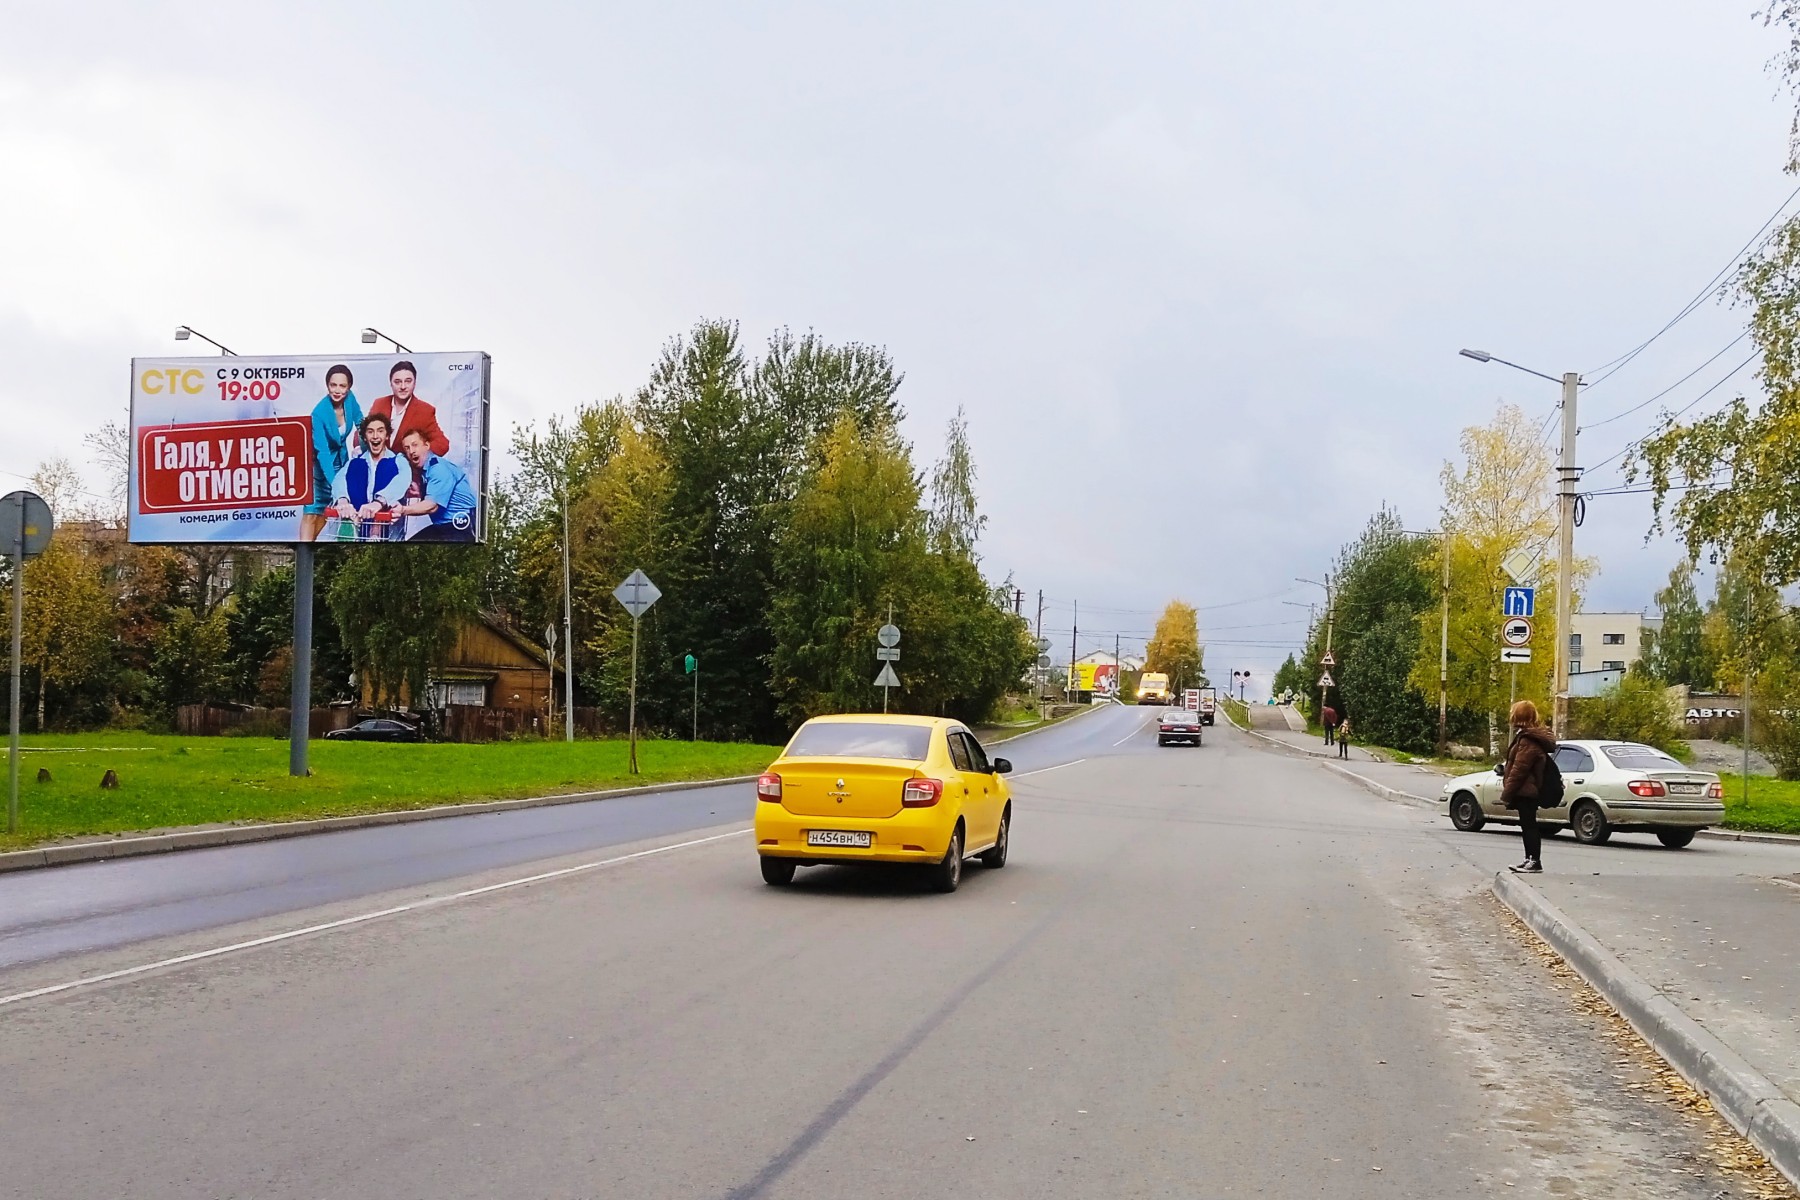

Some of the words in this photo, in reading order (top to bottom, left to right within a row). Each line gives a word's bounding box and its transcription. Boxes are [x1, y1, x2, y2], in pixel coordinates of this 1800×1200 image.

[141, 369, 205, 395] СТС
[217, 368, 227, 379] С
[231, 368, 239, 379] 9
[243, 367, 305, 379] ОКТЯБРЯ
[217, 380, 281, 401] 19:00
[154, 436, 215, 470] Галя,
[218, 439, 233, 469] у
[240, 435, 285, 465] нас
[179, 456, 296, 502] отмена!
[179, 512, 229, 524] комедия
[232, 510, 252, 521] без
[255, 509, 296, 521] скидок
[856, 833, 867, 842] 10
